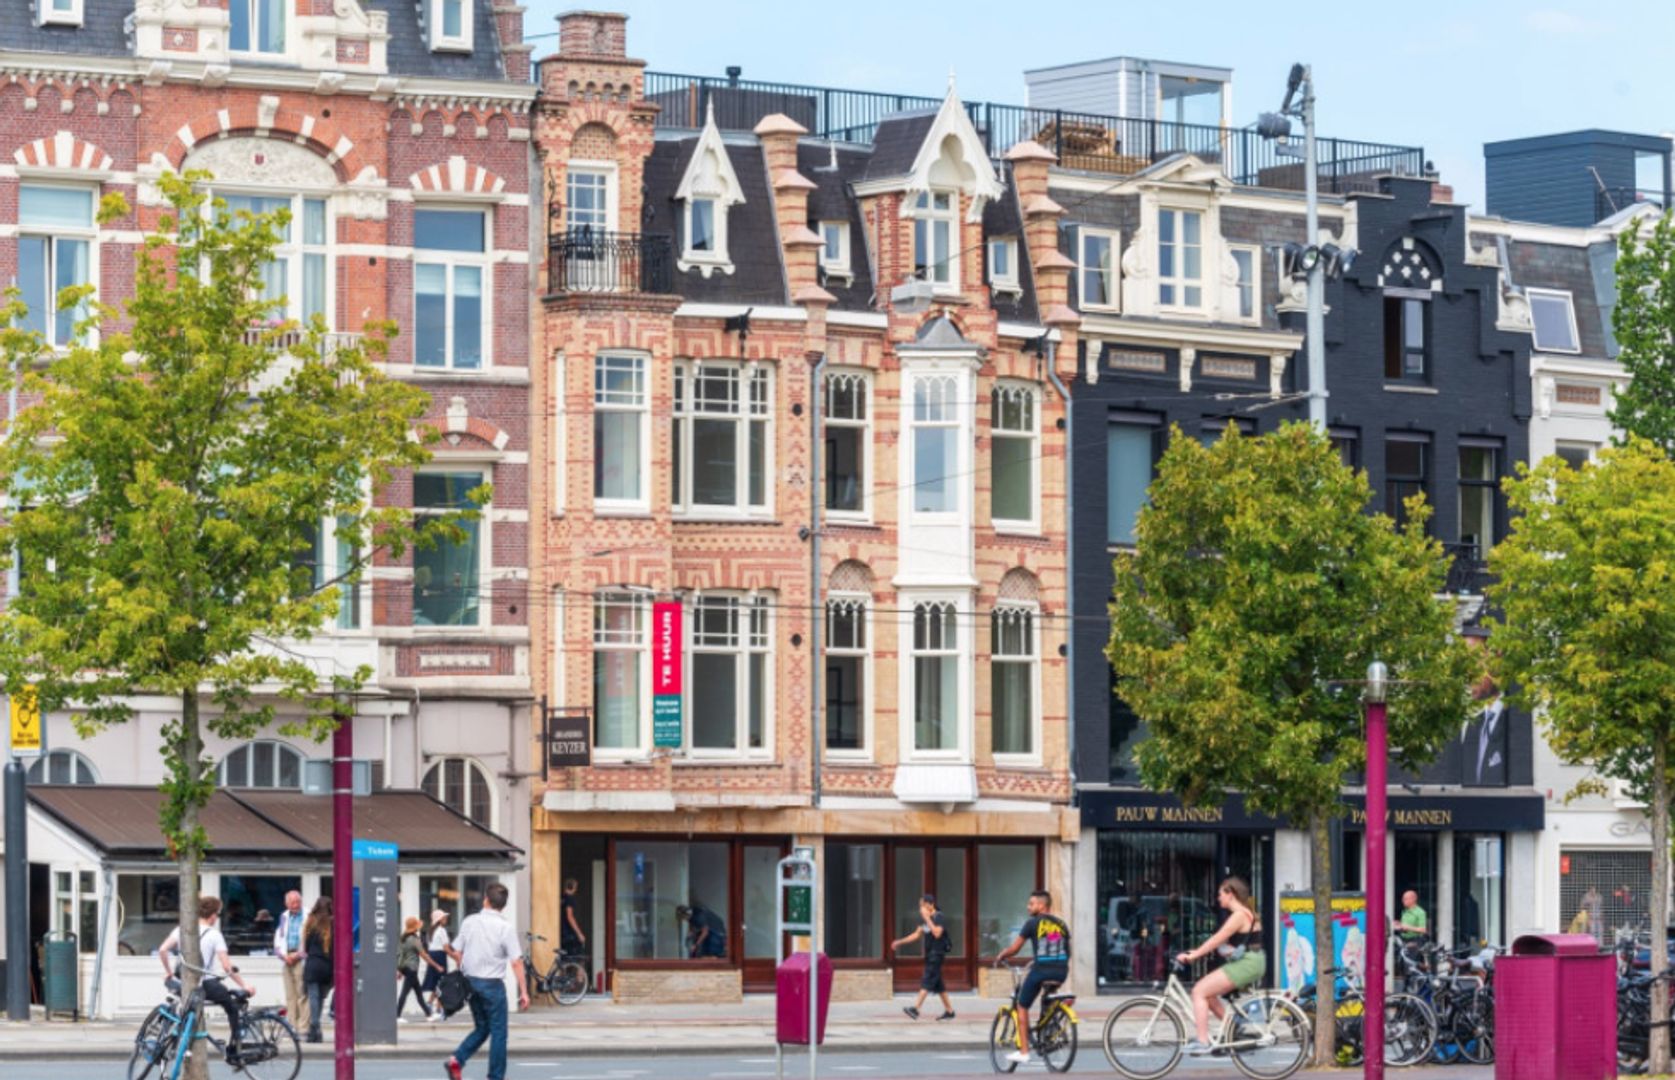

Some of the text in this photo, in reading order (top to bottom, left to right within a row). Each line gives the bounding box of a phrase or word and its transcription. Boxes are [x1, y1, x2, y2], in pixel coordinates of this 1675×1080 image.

[662, 611, 672, 688] TE HUUR
[552, 741, 587, 755] KEYZER
[1116, 806, 1223, 822] PAUW MANNEN
[1394, 809, 1452, 824] MANNEN
[367, 846, 394, 856] Tickets
